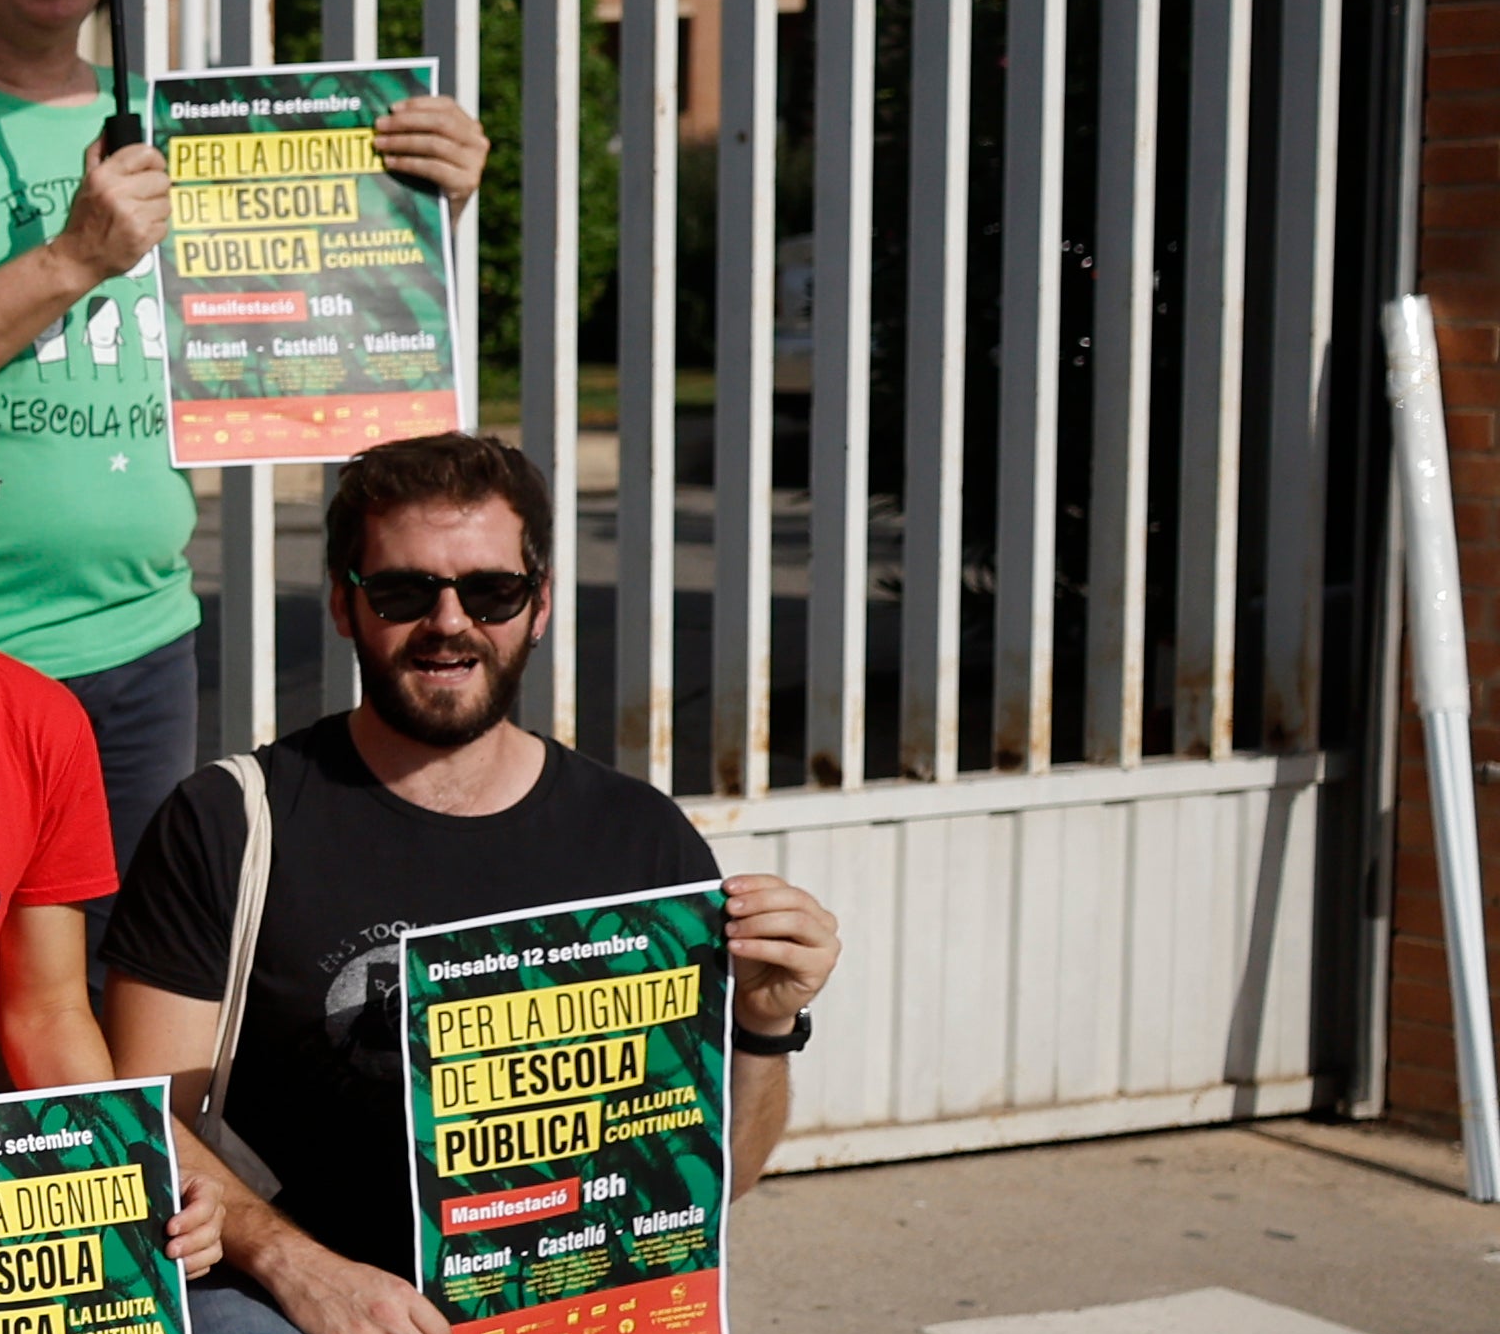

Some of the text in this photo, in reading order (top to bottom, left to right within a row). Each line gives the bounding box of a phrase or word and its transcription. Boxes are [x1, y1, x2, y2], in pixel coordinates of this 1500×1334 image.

[191, 295, 353, 317] Manifestació 18h
[438, 973, 691, 1054] PER LA DIGNITAT
[5, 1127, 93, 1154] setembre
[16, 1173, 139, 1231] DIGNITAT
[444, 1172, 627, 1224] Manifestació 18h
[633, 1204, 705, 1236] València
[68, 1297, 156, 1327] LA LLUITA
